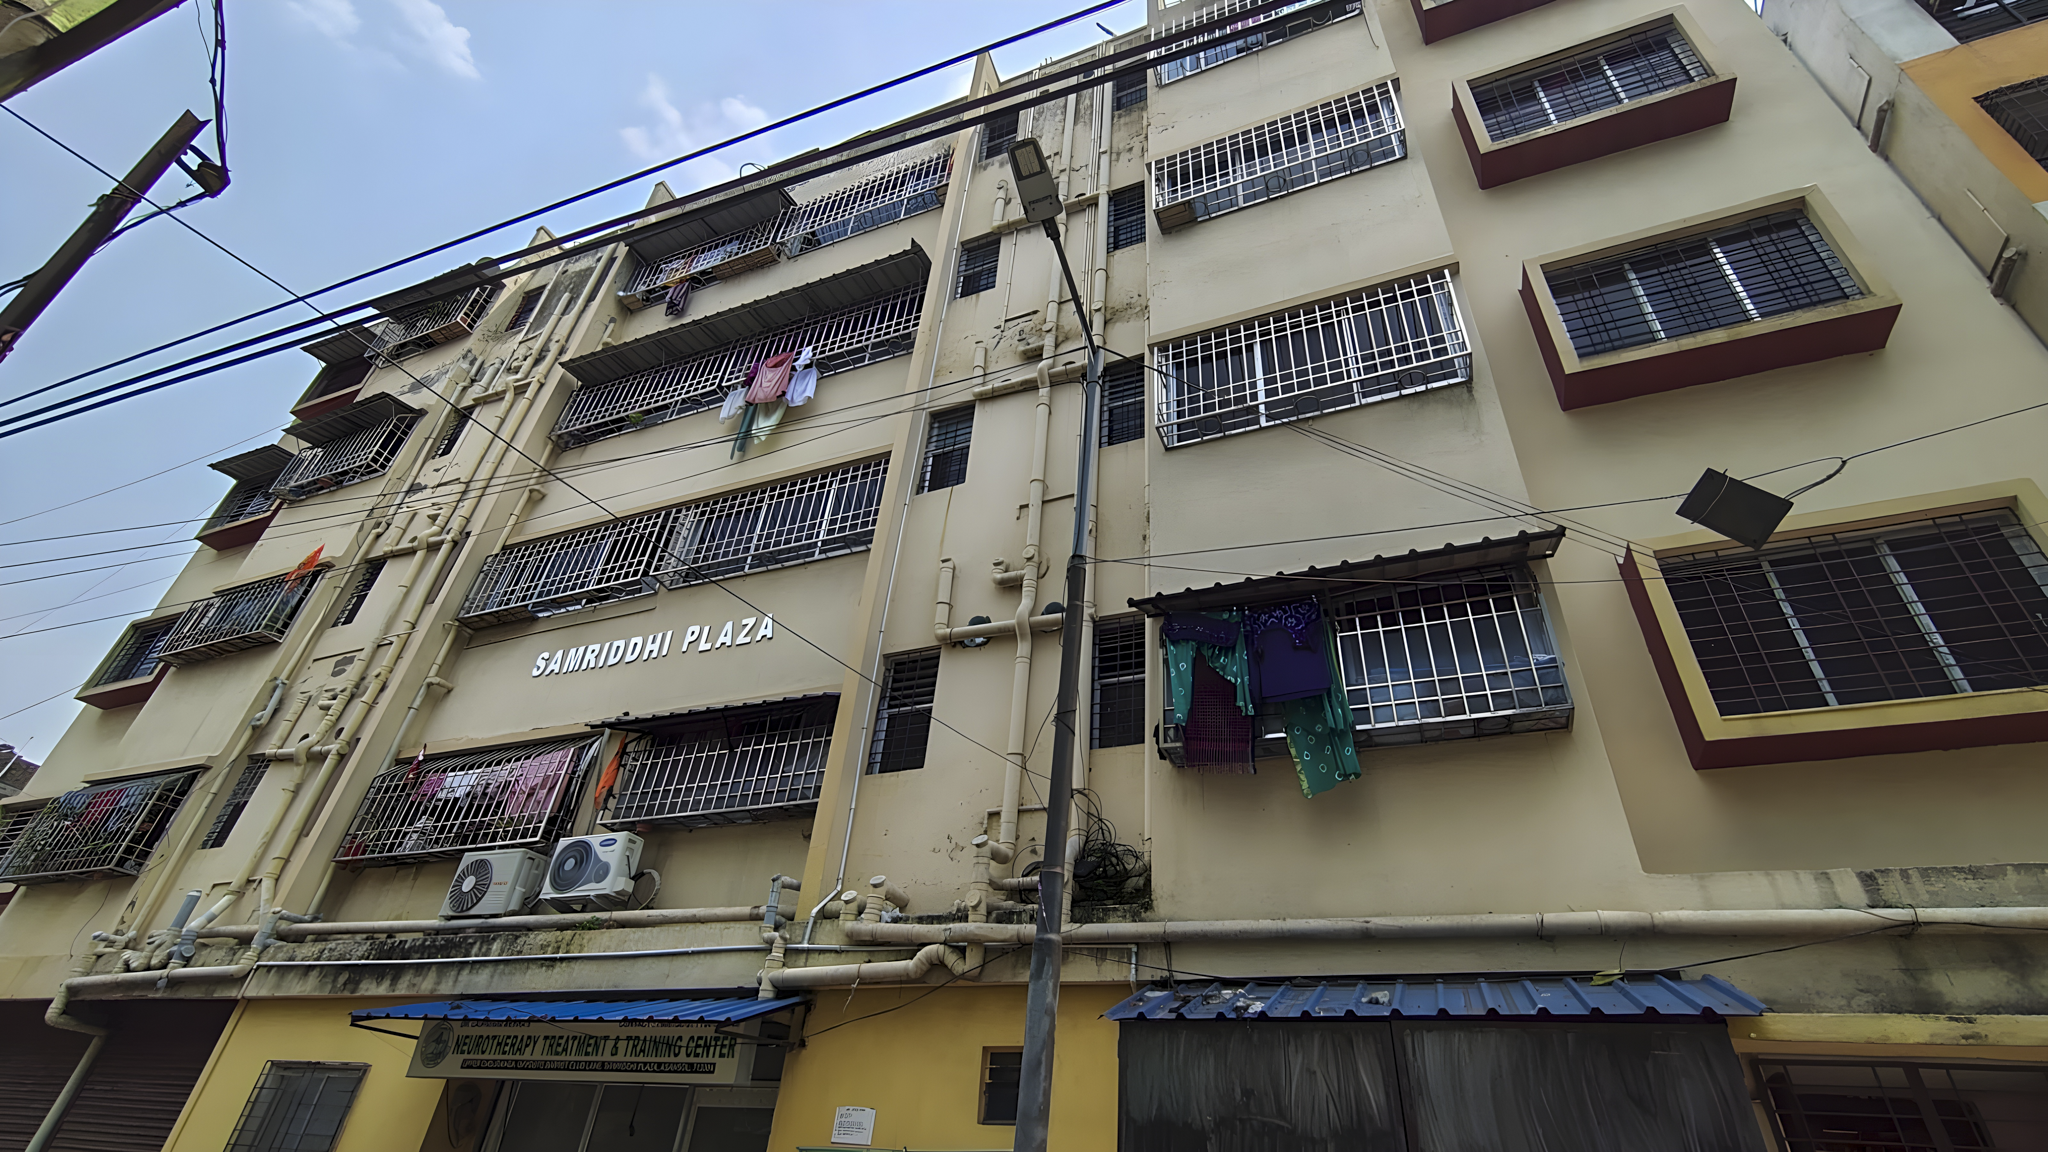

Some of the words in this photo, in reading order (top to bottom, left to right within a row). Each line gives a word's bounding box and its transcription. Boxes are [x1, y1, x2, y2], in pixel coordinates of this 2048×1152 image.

[532, 630, 674, 677] SAMRIDDHI
[681, 613, 774, 653] PLAZA
[452, 1034, 541, 1056] NEUROTHERAPY
[541, 1034, 610, 1057] TREATMENT
[610, 1035, 620, 1057] &
[624, 1035, 683, 1058] TRAINING
[685, 1035, 737, 1059] CENTER
